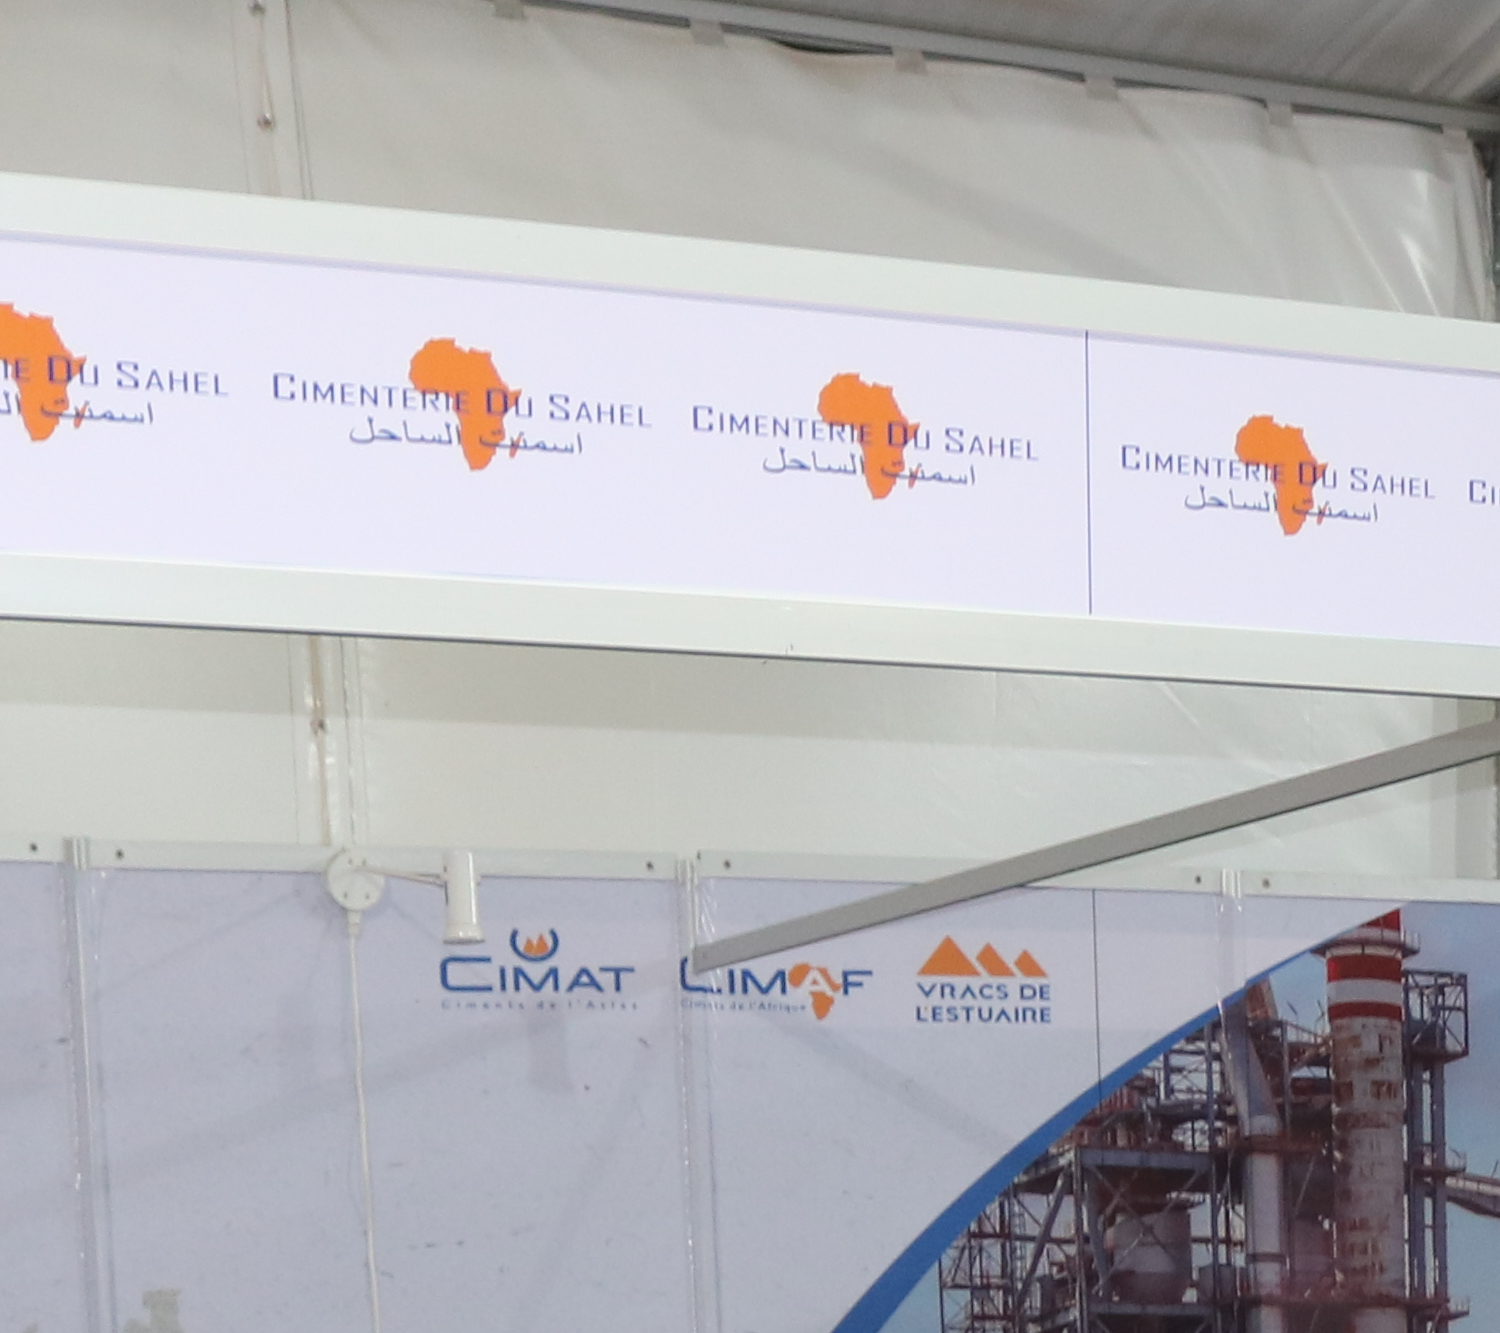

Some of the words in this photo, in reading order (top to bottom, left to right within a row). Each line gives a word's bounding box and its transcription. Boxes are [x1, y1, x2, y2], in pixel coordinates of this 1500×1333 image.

[41, 399, 153, 423] اسمنت
[350, 417, 460, 445] الساحل
[478, 430, 583, 455] اسمنت
[763, 447, 864, 476] الساحل
[881, 463, 976, 486] اسمنت
[1184, 486, 1278, 514] الساحل
[1290, 500, 1379, 523] اسمنت
[440, 957, 634, 993] CIMAT
[916, 983, 1009, 1000] VRACS
[1020, 984, 1050, 1000] DE
[916, 1005, 1051, 1024] L'ESTUAIRE
